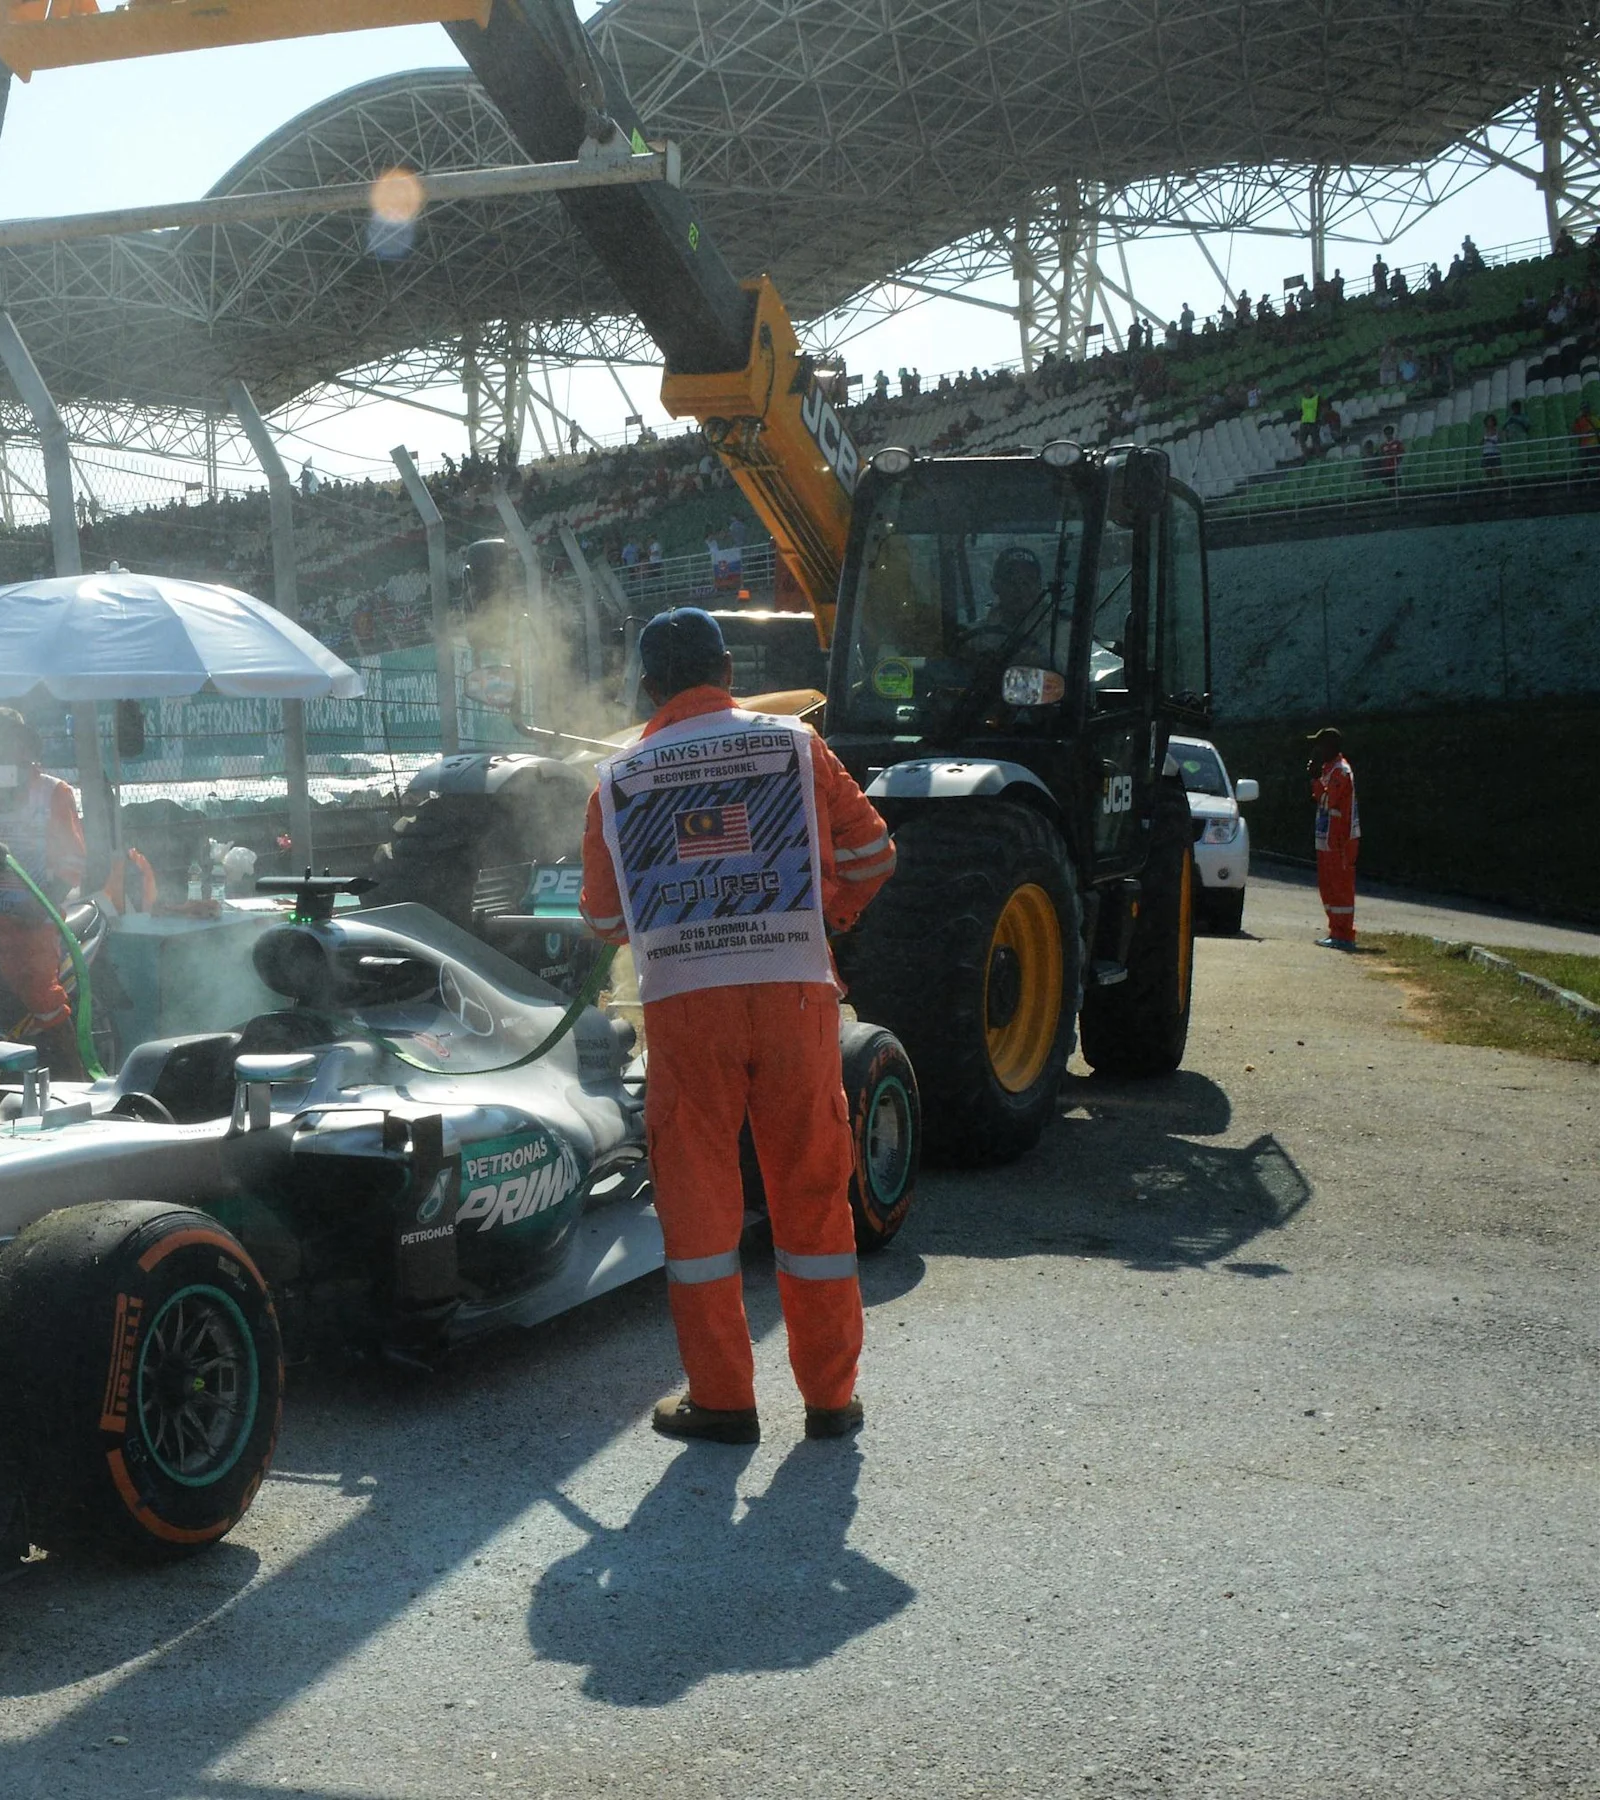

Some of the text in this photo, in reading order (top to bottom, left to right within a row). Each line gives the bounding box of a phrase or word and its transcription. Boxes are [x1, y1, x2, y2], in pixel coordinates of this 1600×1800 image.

[802, 386, 859, 497] JCB
[660, 734, 792, 764] MYS1759 2016
[653, 761, 758, 785] RECOVERY PERSONNEL
[1103, 775, 1132, 814] JCB
[660, 870, 781, 905] COURSE
[647, 942, 692, 961] PETRONAS
[694, 935, 747, 953] MALAYSIA
[750, 931, 785, 947] GRAND
[787, 930, 810, 944] PRIX
[679, 920, 767, 941] 2016 FORMULA 1
[466, 1137, 548, 1181] PETRONAS
[401, 1224, 454, 1245] PETRONAS
[100, 1292, 143, 1433] PIRELLI
